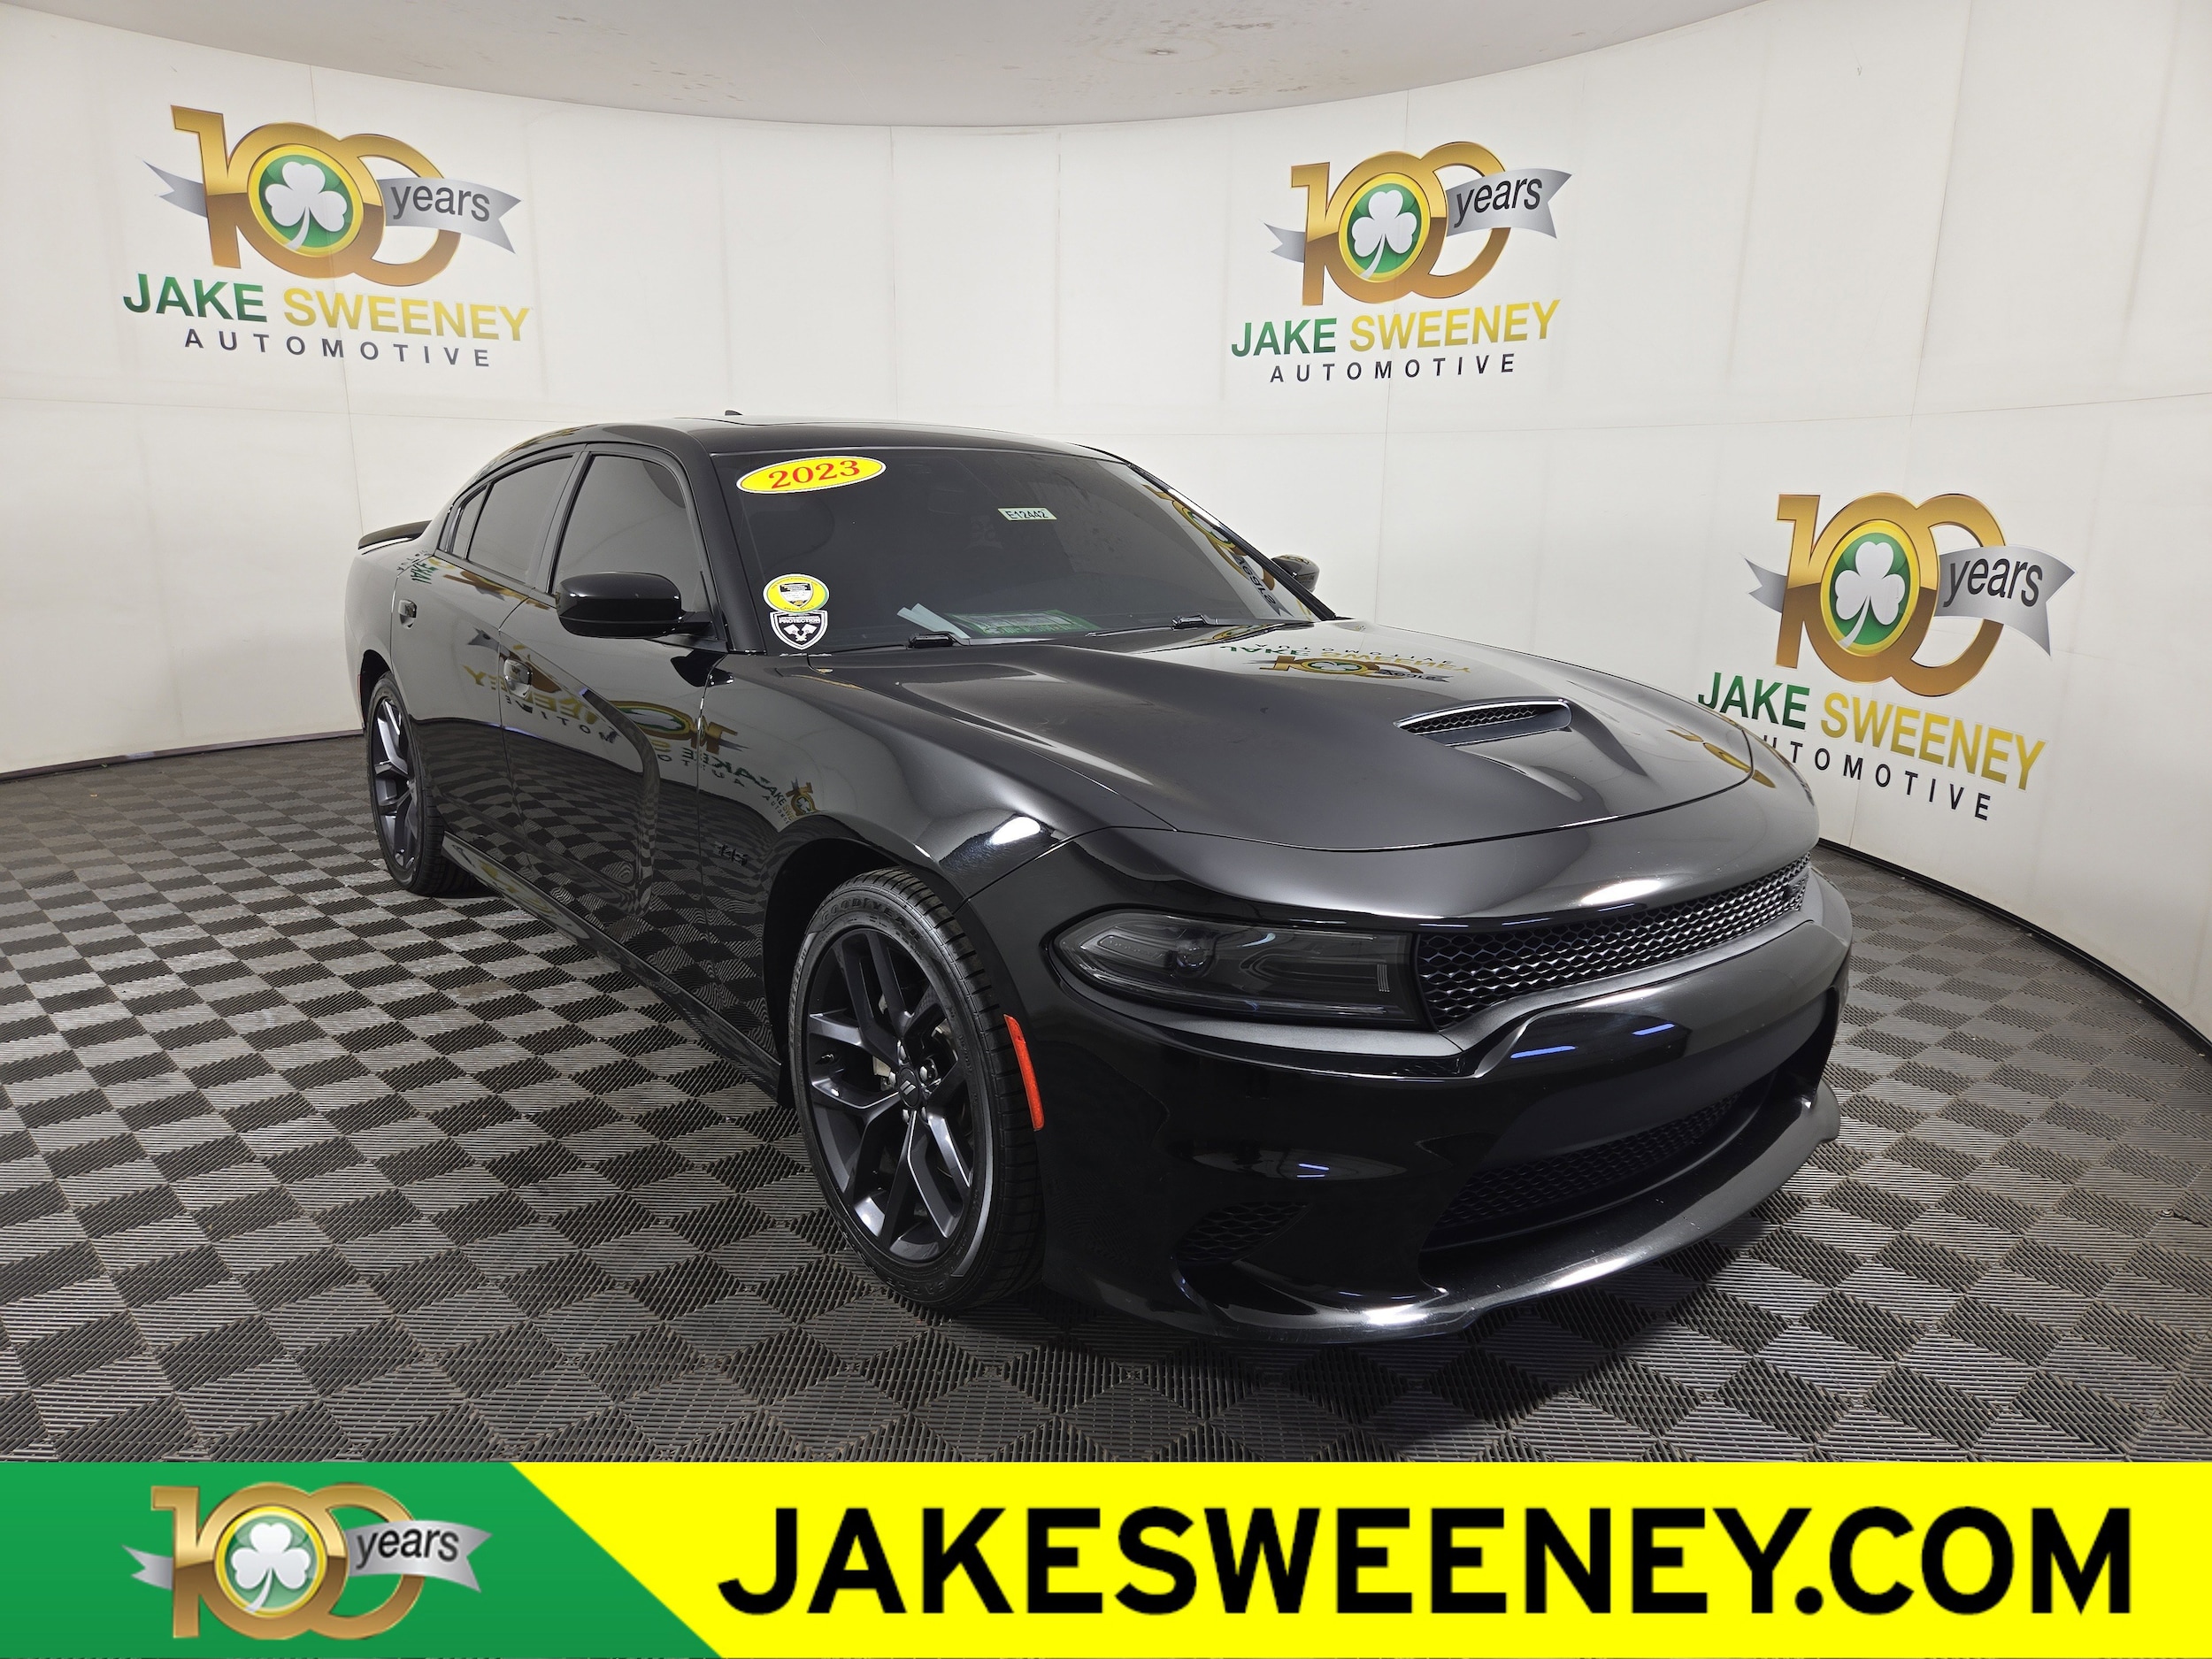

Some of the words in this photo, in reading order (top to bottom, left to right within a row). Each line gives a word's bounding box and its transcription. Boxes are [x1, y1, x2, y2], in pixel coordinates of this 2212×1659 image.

[171, 104, 461, 287] 100
[391, 184, 490, 222] years
[1290, 141, 1512, 306] 100
[1454, 176, 1542, 228] years
[122, 273, 267, 323] JAKE
[283, 288, 530, 342] SWEENEY
[1231, 317, 1337, 357] JAKE
[1349, 299, 1561, 352] SWEENEY
[184, 327, 489, 367] AUTOMOTIVE
[1270, 353, 1515, 383] AUTOMOTIVE
[768, 459, 861, 489] 2023
[1004, 511, 1049, 519] E12442
[1775, 492, 2007, 697] 100
[1942, 557, 2044, 607] years
[1698, 672, 1810, 730] JAKE
[1820, 692, 2047, 792] SWEENEY
[1763, 734, 1992, 822] TOMOTIVE
